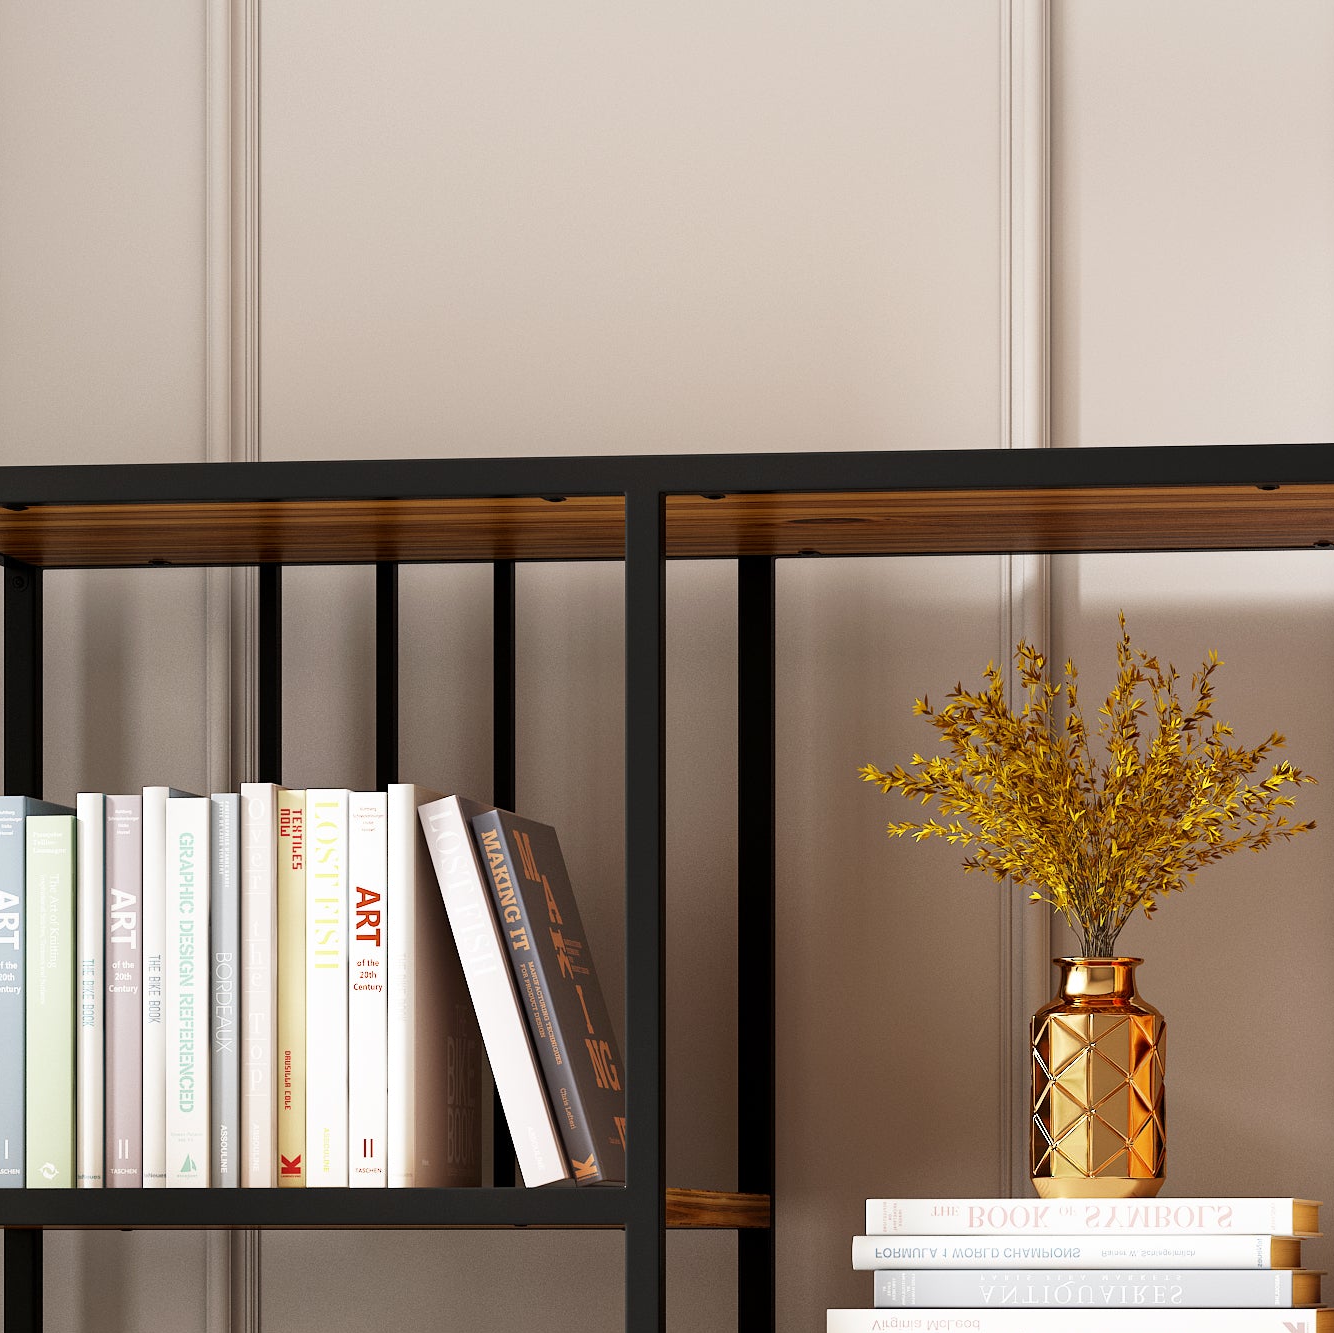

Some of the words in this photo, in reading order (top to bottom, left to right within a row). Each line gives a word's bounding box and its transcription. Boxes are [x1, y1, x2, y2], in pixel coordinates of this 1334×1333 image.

[280, 808, 291, 837] NOW
[292, 808, 303, 871] TEXTILES
[314, 802, 340, 887] LOST
[49, 873, 60, 893] The
[179, 832, 194, 914] GRAPHIC
[481, 828, 522, 924] MAKING
[510, 927, 530, 951] IT
[49, 896, 60, 914] Art
[49, 915, 60, 926] of
[111, 888, 137, 950] ART
[355, 886, 381, 947] ART
[47, 927, 60, 968] Knitting
[179, 920, 194, 987] DESIGN
[314, 898, 340, 969] FISH
[5, 961, 18, 970] the
[148, 954, 162, 973] THE
[148, 976, 162, 996] BIKE
[353, 983, 383, 993] Century
[148, 1000, 162, 1024] BOOK
[215, 952, 233, 1053] BORDEAUX
[179, 993, 194, 1113] REFERENCED
[220, 1124, 228, 1173] ASSOULINE
